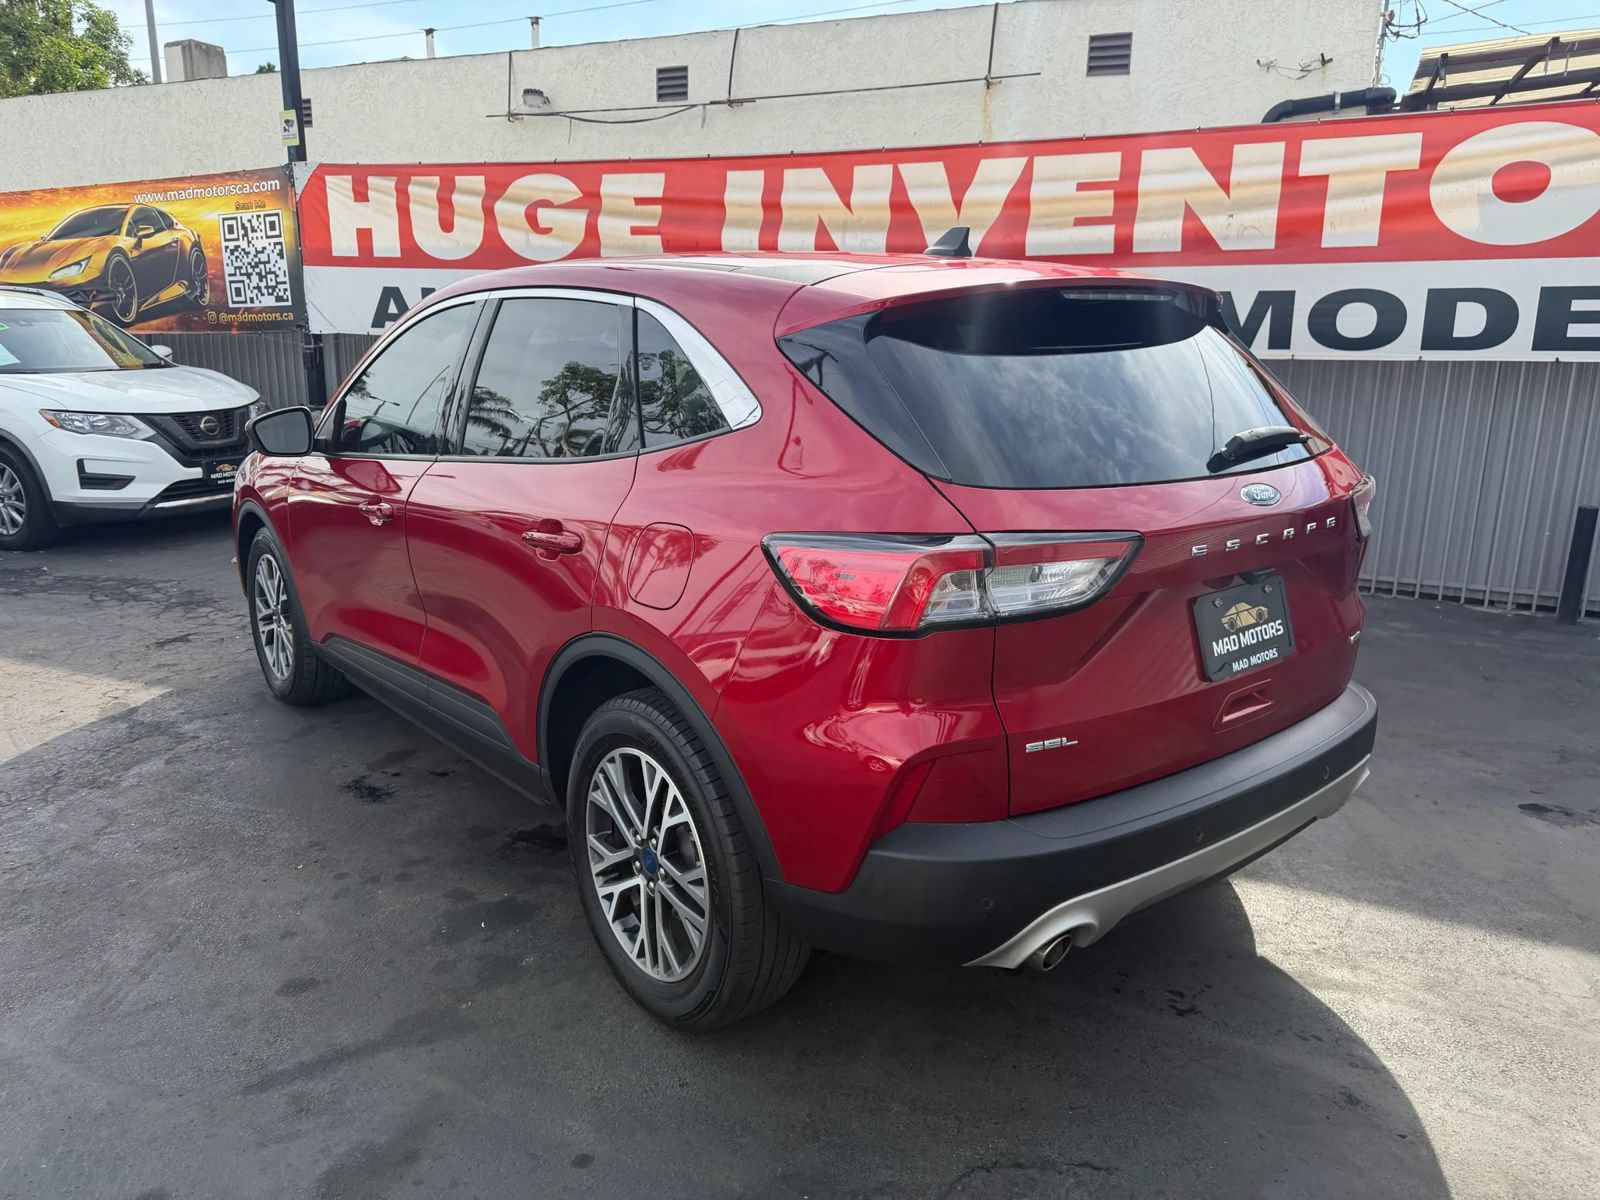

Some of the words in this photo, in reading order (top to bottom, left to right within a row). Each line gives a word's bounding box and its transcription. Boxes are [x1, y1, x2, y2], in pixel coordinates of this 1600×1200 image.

[134, 179, 280, 203] www.madmotorsca.com
[324, 172, 666, 261] HUGE
[721, 121, 1600, 257] INVENTO
[219, 312, 294, 322] @madmotors.ca
[1251, 486, 1276, 500] Ford
[1191, 516, 1336, 557] ESCAPE
[1212, 634, 1239, 657] MAD
[1239, 619, 1284, 648] MOTORS
[1232, 658, 1249, 673] MAD
[1249, 647, 1278, 667] MOTORS
[1025, 737, 1078, 753] SEL
